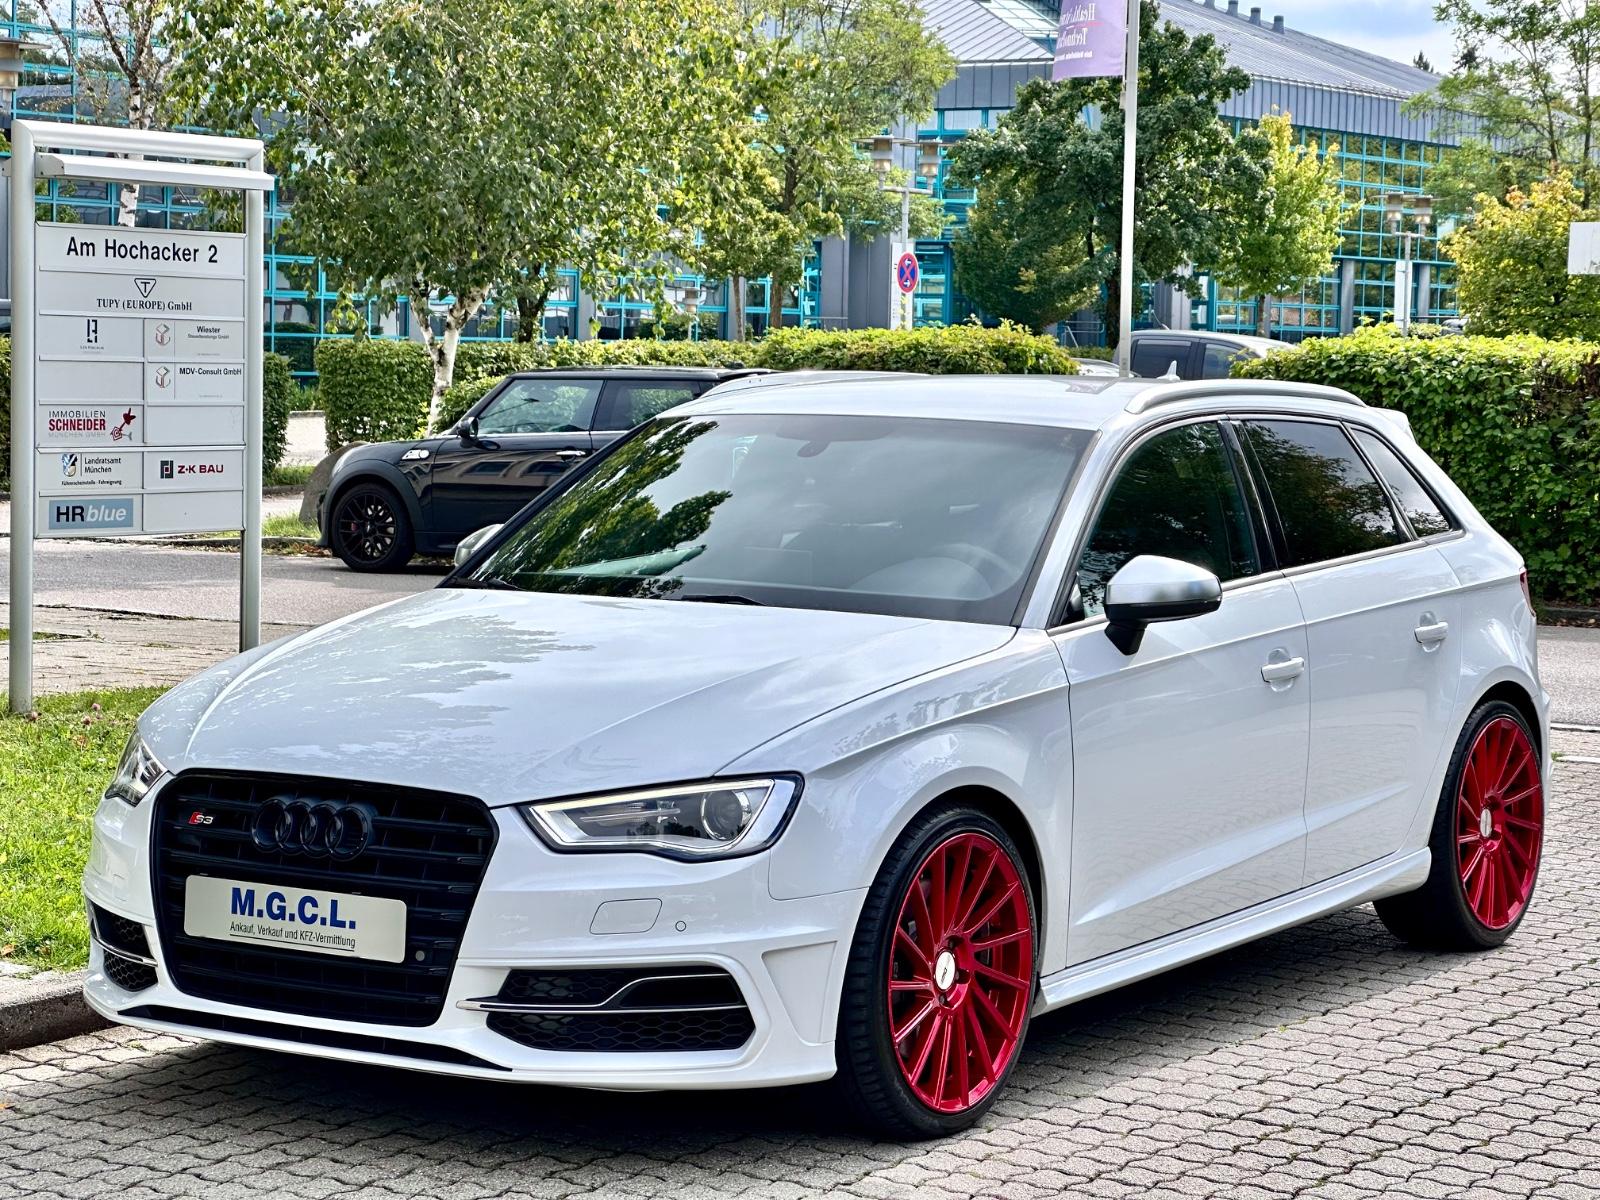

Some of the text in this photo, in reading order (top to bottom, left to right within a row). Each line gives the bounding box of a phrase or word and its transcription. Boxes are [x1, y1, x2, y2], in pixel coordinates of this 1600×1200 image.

[66, 236, 218, 263] Am Hochacker 2
[96, 298, 192, 311] TUPY (EUROPE) GmbH
[179, 367, 242, 376] MDV-Consult GmbH
[48, 410, 106, 418] IMMOBILIEN
[48, 418, 106, 431] SCHNEIDER
[84, 457, 122, 465] Landratsamt
[199, 464, 224, 474] BAU
[231, 887, 356, 929] M.G.C.L.
[230, 921, 356, 949] Ankauf, Verkauf und KFZ-Vermittlung
